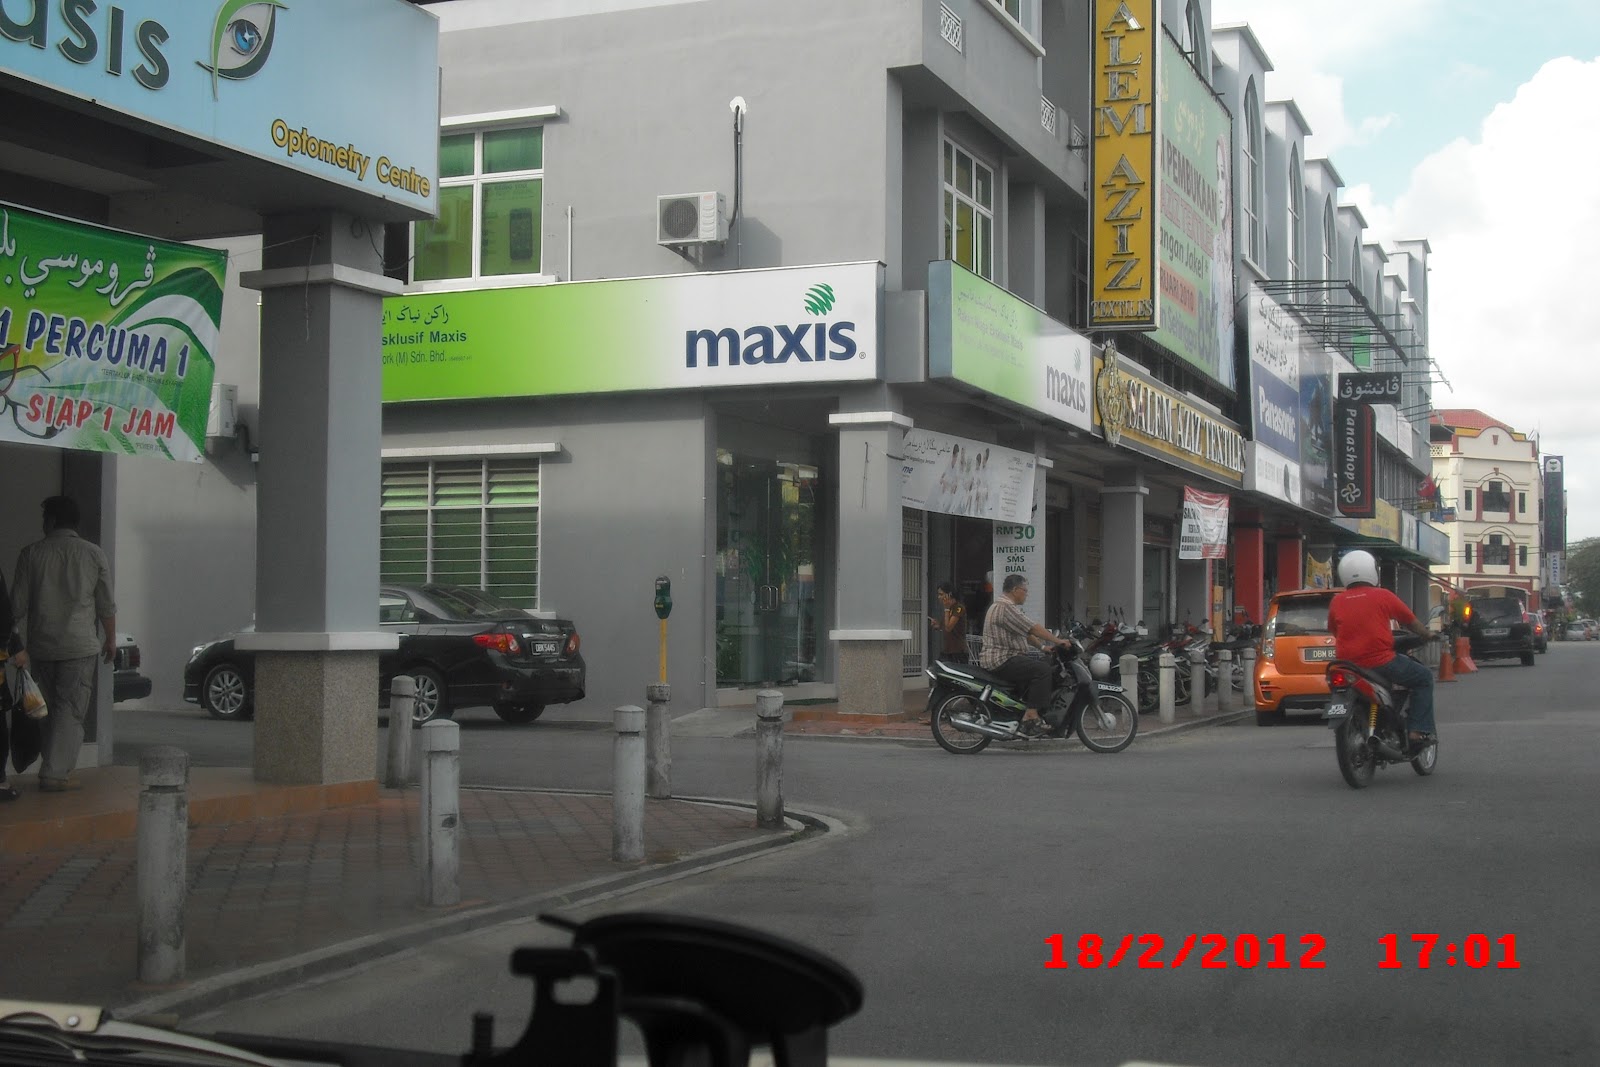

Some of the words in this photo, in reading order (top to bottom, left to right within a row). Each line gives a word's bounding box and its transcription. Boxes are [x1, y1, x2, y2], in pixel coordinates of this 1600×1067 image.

[270, 118, 370, 181] Optometry
[376, 155, 430, 198] Centre
[1102, 153, 1145, 290] AZIZ
[1091, 299, 1154, 319] TEXTILES
[25, 312, 167, 373] PERCUMA
[177, 344, 189, 377] 1
[382, 331, 424, 346] sklusif
[430, 330, 467, 343] Maxis
[410, 350, 427, 363] Sdn.
[430, 350, 447, 362] Bhd.
[686, 321, 857, 368] maxis
[1046, 365, 1086, 413] maxis
[26, 393, 94, 429] SIAP
[104, 406, 113, 431] 1
[123, 407, 175, 438] JAM
[1126, 378, 1173, 444] SALEM
[1176, 403, 1202, 456] AZIZ
[1204, 418, 1247, 473] TEXTILES
[1258, 385, 1296, 443] Panasonic
[1344, 408, 1358, 480] Panashop
[996, 525, 1035, 539] RM30
[996, 545, 1035, 553] INTERNET
[1005, 565, 1026, 573] BUAL
[1007, 555, 1025, 563] SMS
